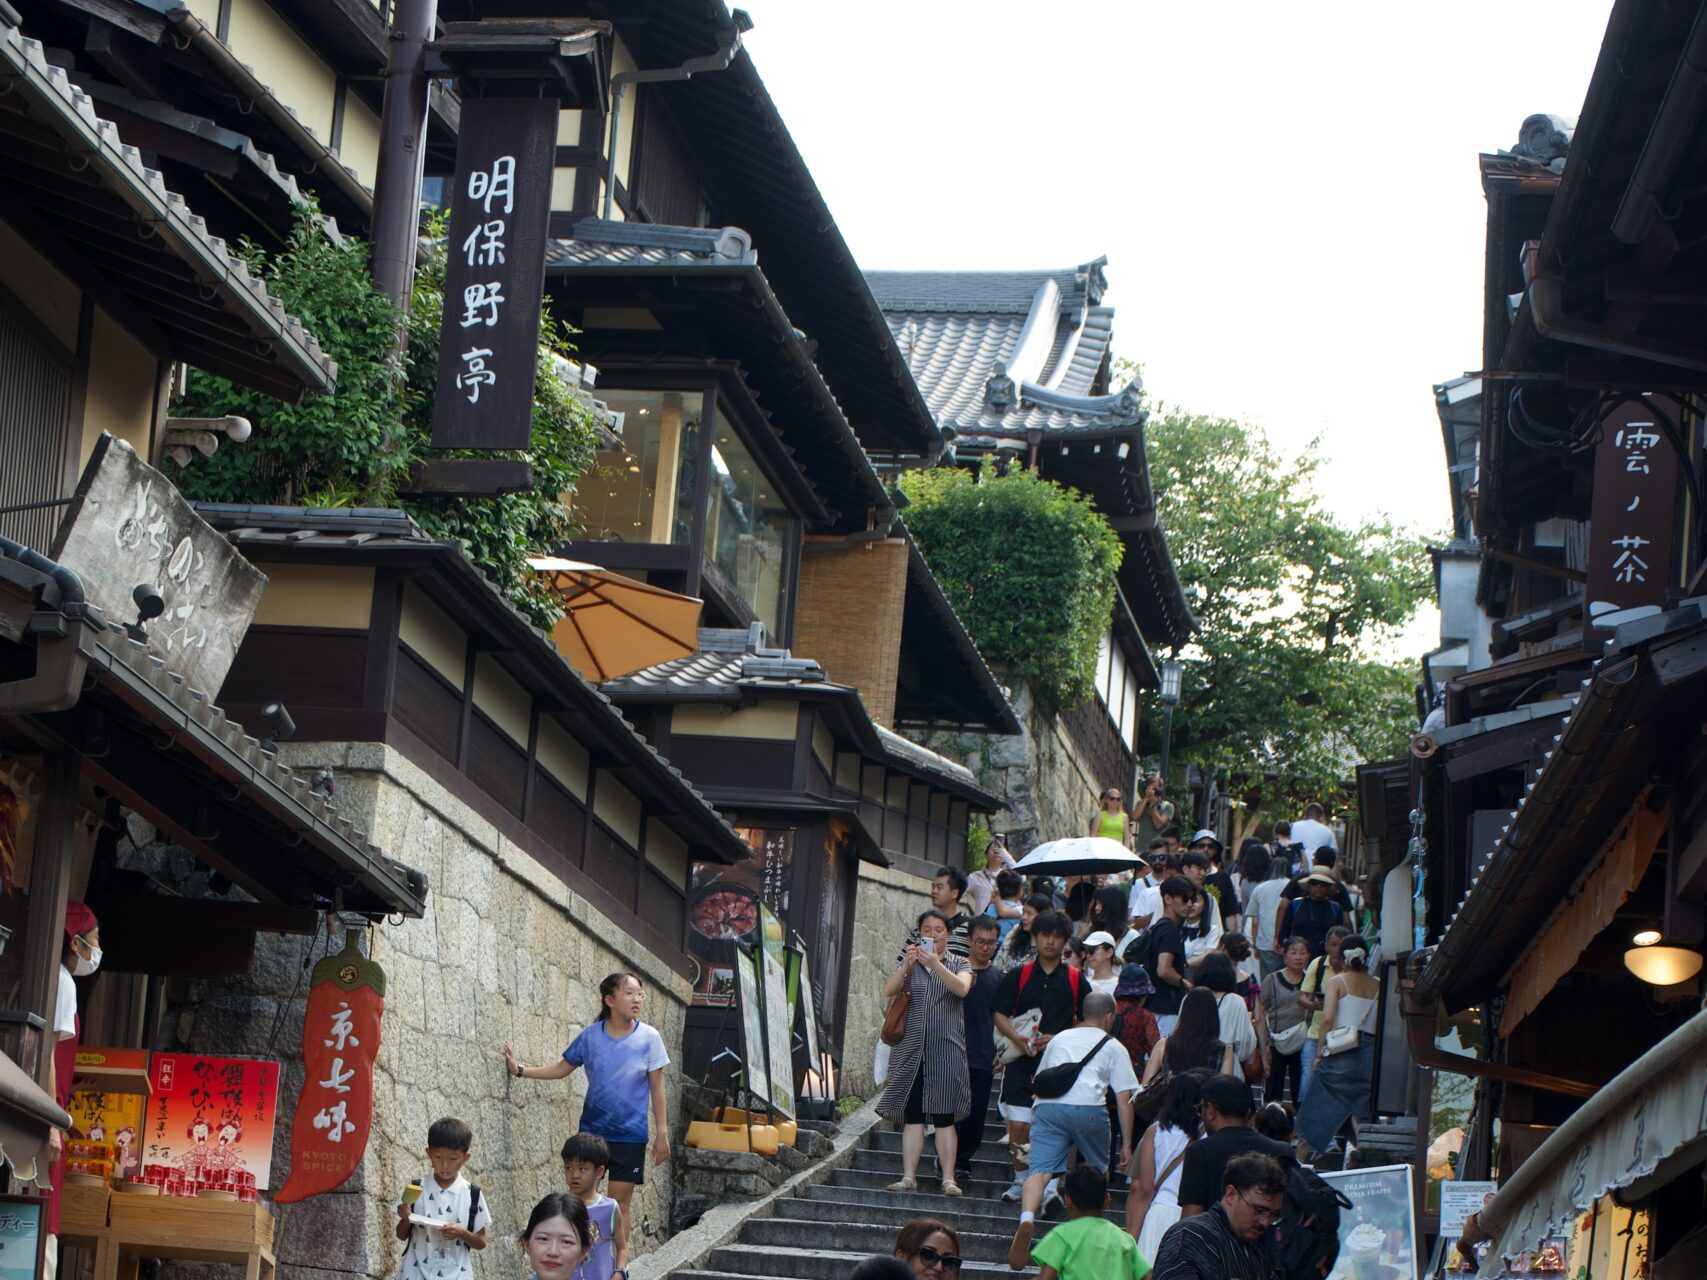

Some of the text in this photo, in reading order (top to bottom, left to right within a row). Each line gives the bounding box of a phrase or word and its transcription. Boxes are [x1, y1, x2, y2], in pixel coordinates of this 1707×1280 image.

[455, 155, 516, 404] 明保野亭
[1611, 421, 1660, 583] 雲ノ茶
[313, 1001, 360, 1143] 京七味
[303, 1150, 346, 1162] KYOTO
[303, 1161, 346, 1173] SPICE
[1344, 1181, 1383, 1191] PREMIUM
